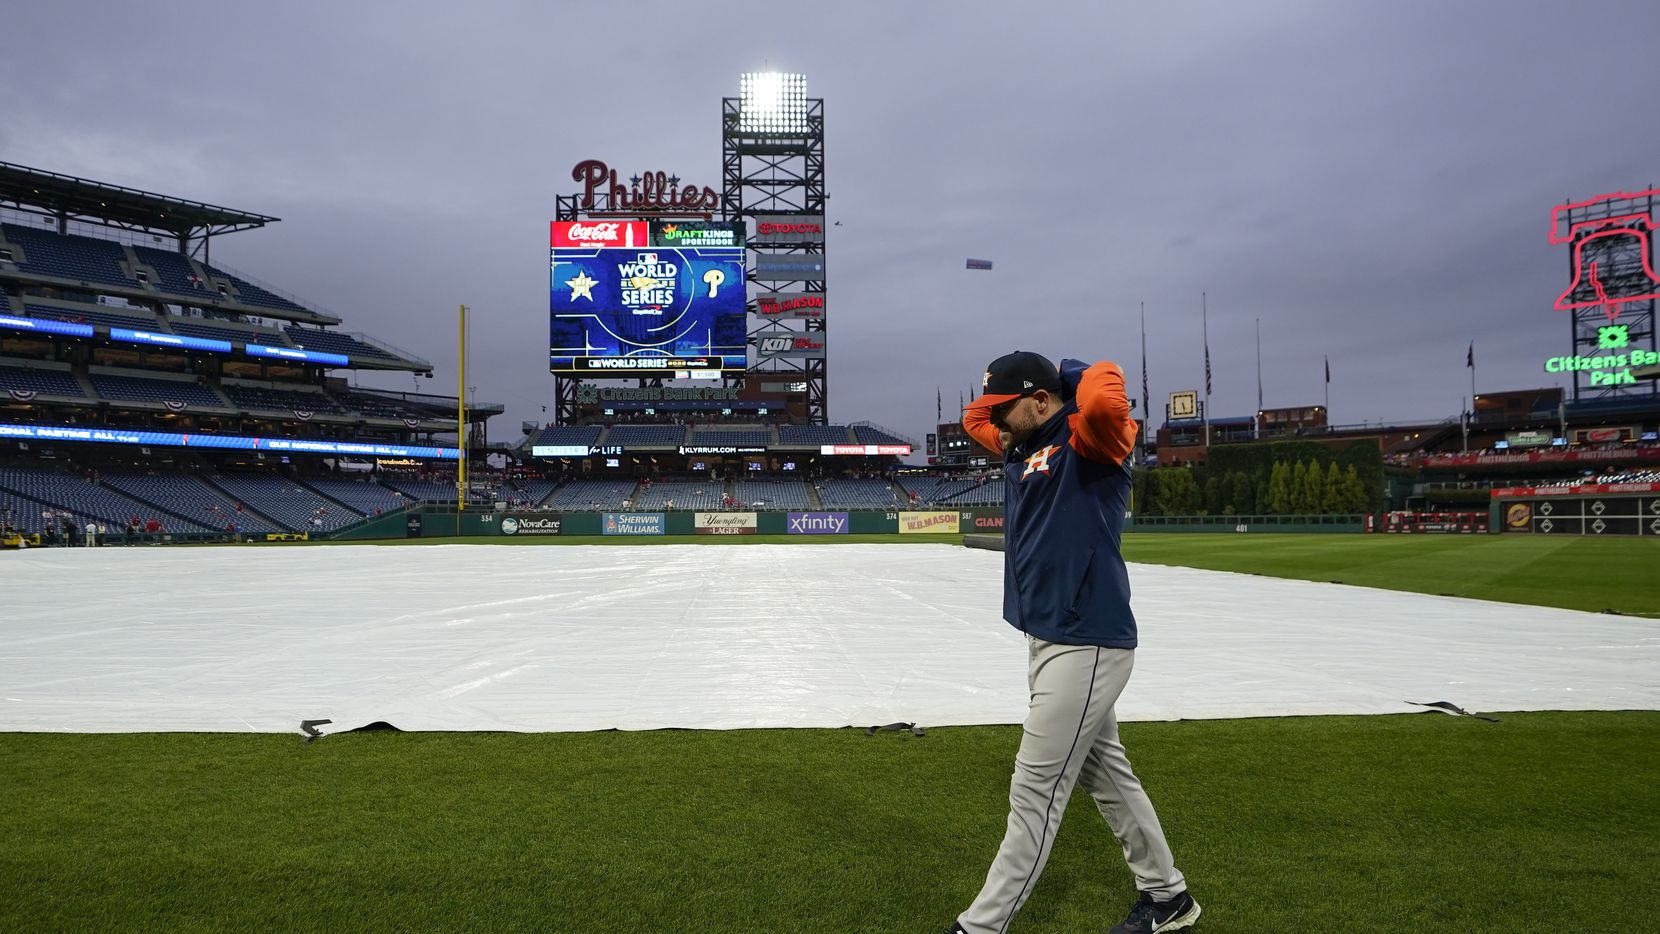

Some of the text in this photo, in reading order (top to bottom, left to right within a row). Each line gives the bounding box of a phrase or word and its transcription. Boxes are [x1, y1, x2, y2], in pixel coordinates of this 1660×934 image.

[572, 160, 719, 210] Phillies
[774, 223, 822, 234] TOYOTA
[664, 229, 734, 240] DRAFTKINGS
[681, 238, 734, 246] SPORTSBOOK
[617, 263, 678, 278] WORLD
[702, 269, 725, 299] P
[621, 290, 674, 305] SERIES
[601, 359, 637, 368] WORLD
[637, 359, 668, 368] SERIES
[1544, 349, 1660, 373] Citizens Ba
[1590, 368, 1637, 386] Park
[600, 386, 738, 401] Citizens Bank Park
[94, 432, 116, 440] ALL
[588, 446, 600, 455] for
[601, 446, 622, 455] LIFE
[518, 518, 561, 529] NovaCare
[618, 514, 660, 524] SHERWIN
[702, 513, 750, 526] Yuengling
[791, 513, 845, 533] xfinity
[975, 517, 1004, 527] GIAN
[712, 527, 740, 535] LAGER
[1235, 524, 1248, 533] 401
